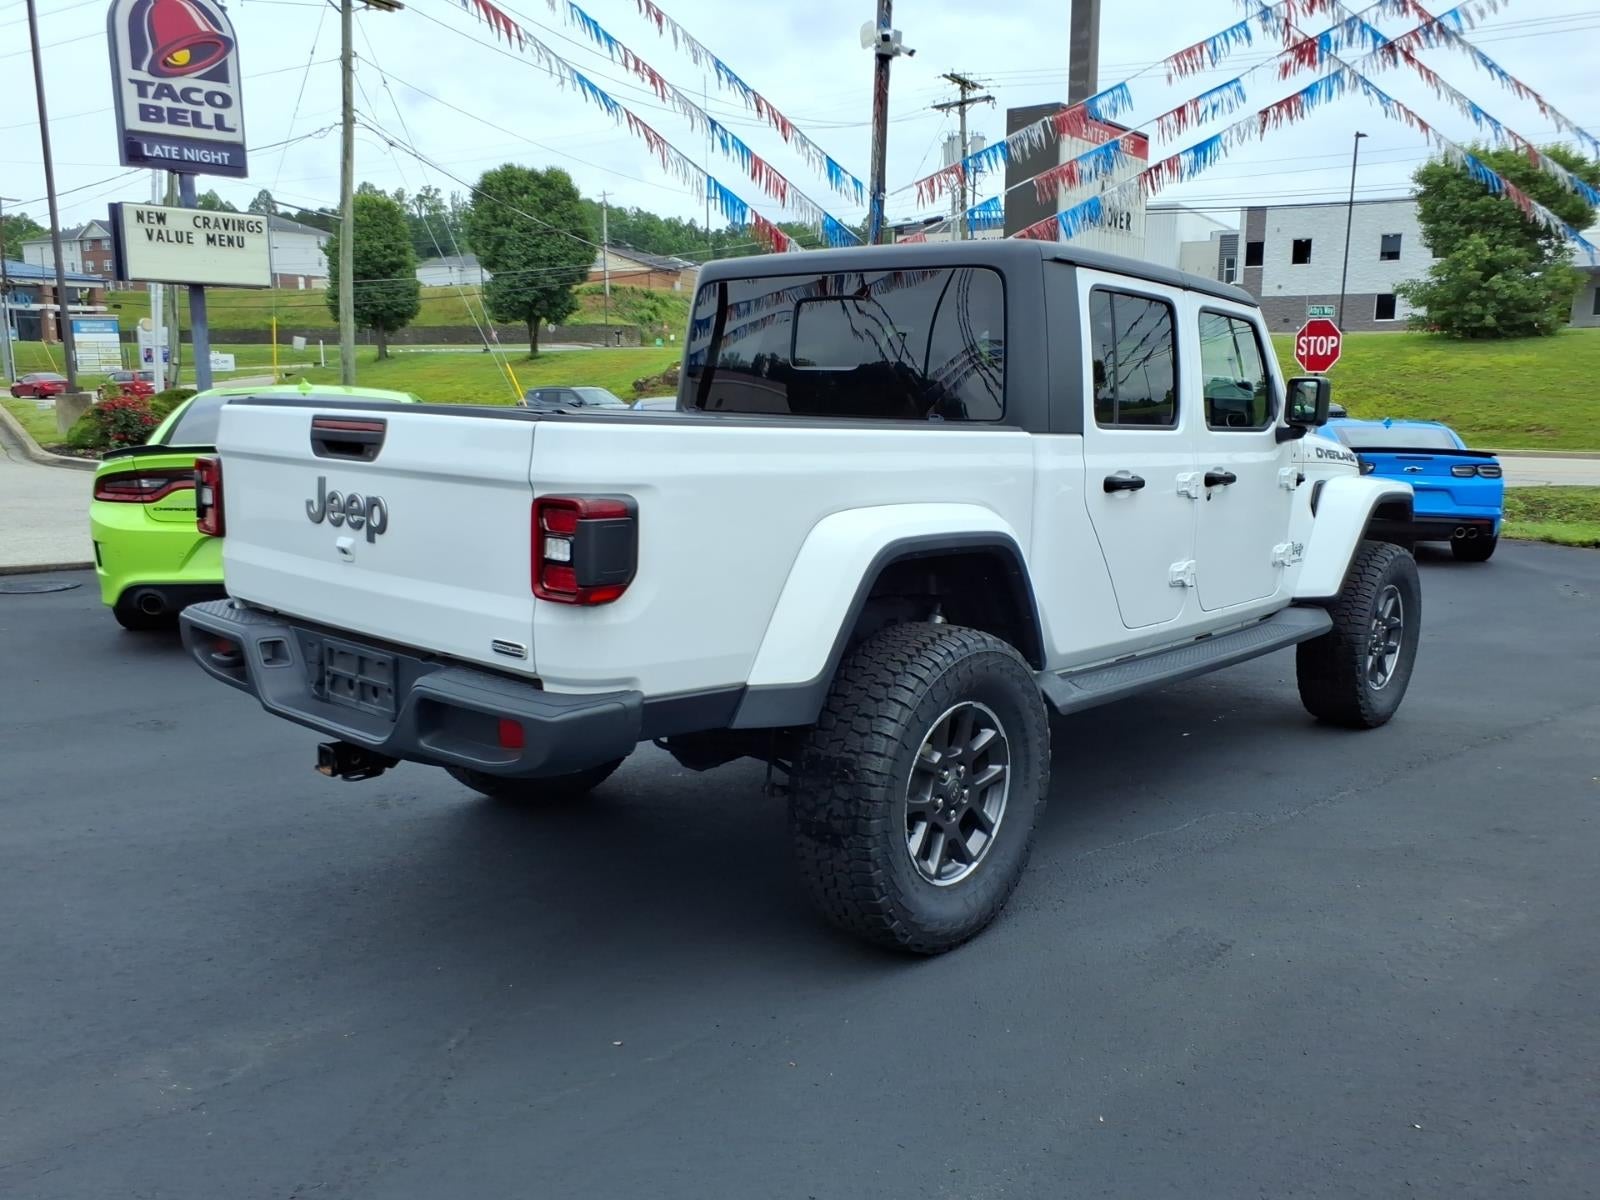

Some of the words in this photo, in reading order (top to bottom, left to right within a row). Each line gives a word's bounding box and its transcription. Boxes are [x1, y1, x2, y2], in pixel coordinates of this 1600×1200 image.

[128, 78, 233, 109] TACO
[139, 103, 237, 133] BELL
[1082, 124, 1109, 144] ENTER
[143, 143, 179, 160] LATE
[184, 148, 230, 165] NIGHT
[136, 210, 167, 226] NEW
[193, 215, 263, 234] CRAVINGS
[145, 228, 194, 245] VALUE
[207, 233, 245, 249] MENU
[1298, 336, 1338, 356] STOP
[305, 476, 388, 544] Jeep
